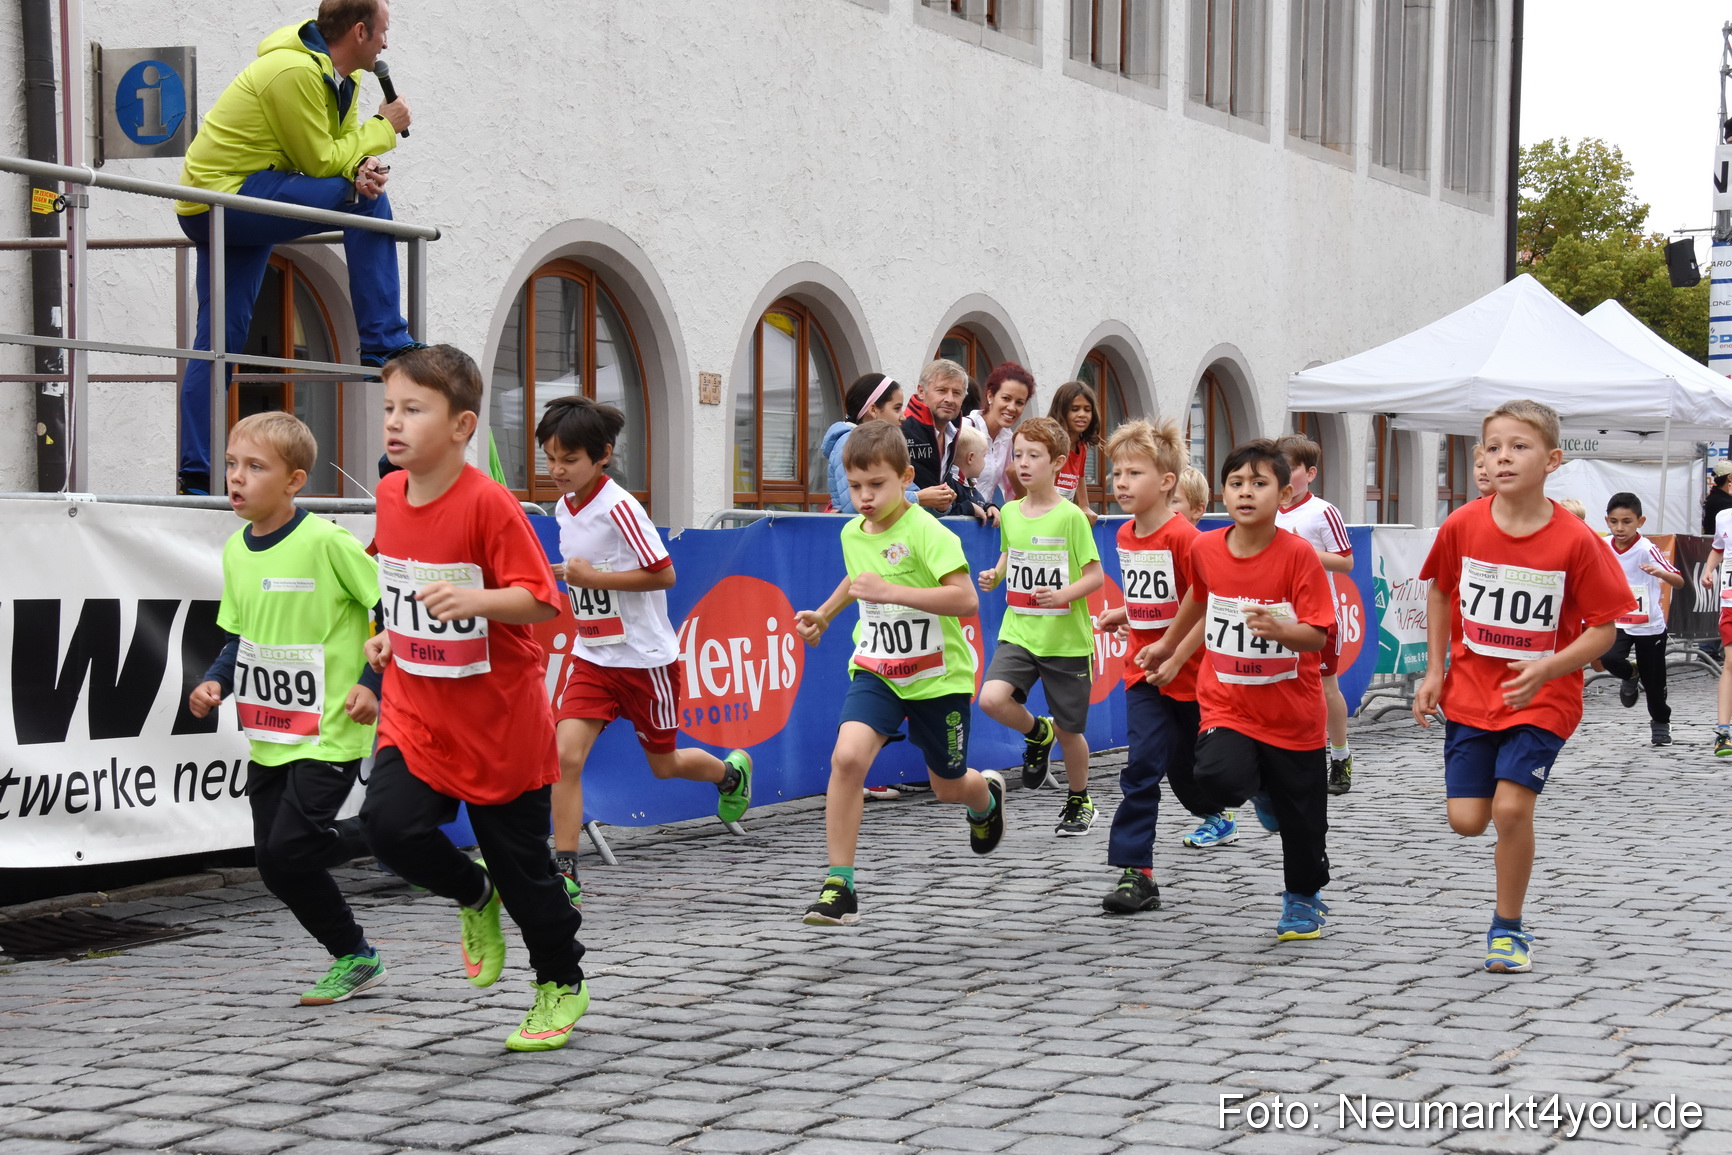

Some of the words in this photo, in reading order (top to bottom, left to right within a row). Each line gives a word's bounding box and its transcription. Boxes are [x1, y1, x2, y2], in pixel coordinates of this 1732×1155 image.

[1134, 553, 1166, 563] BOCK
[414, 567, 472, 581] BOCK
[1012, 565, 1063, 590] 7044
[1121, 568, 1169, 599] 226
[1468, 569, 1498, 580] NeuerMarkt
[1505, 568, 1557, 586] BOCK
[1027, 597, 1040, 606] Ja
[1469, 582, 1553, 627] 7104
[578, 622, 599, 635] mon
[869, 619, 930, 654] 7007
[1214, 617, 1283, 654] 714
[1477, 628, 1532, 648] Thomas
[260, 647, 314, 661] BOCK
[410, 642, 446, 662] Felix
[678, 616, 796, 711] Hervis
[876, 663, 918, 677] Marlon
[1235, 661, 1262, 673] Luis
[236, 661, 316, 707] 7089
[255, 711, 292, 730] Linus
[683, 702, 749, 728] SPORTS
